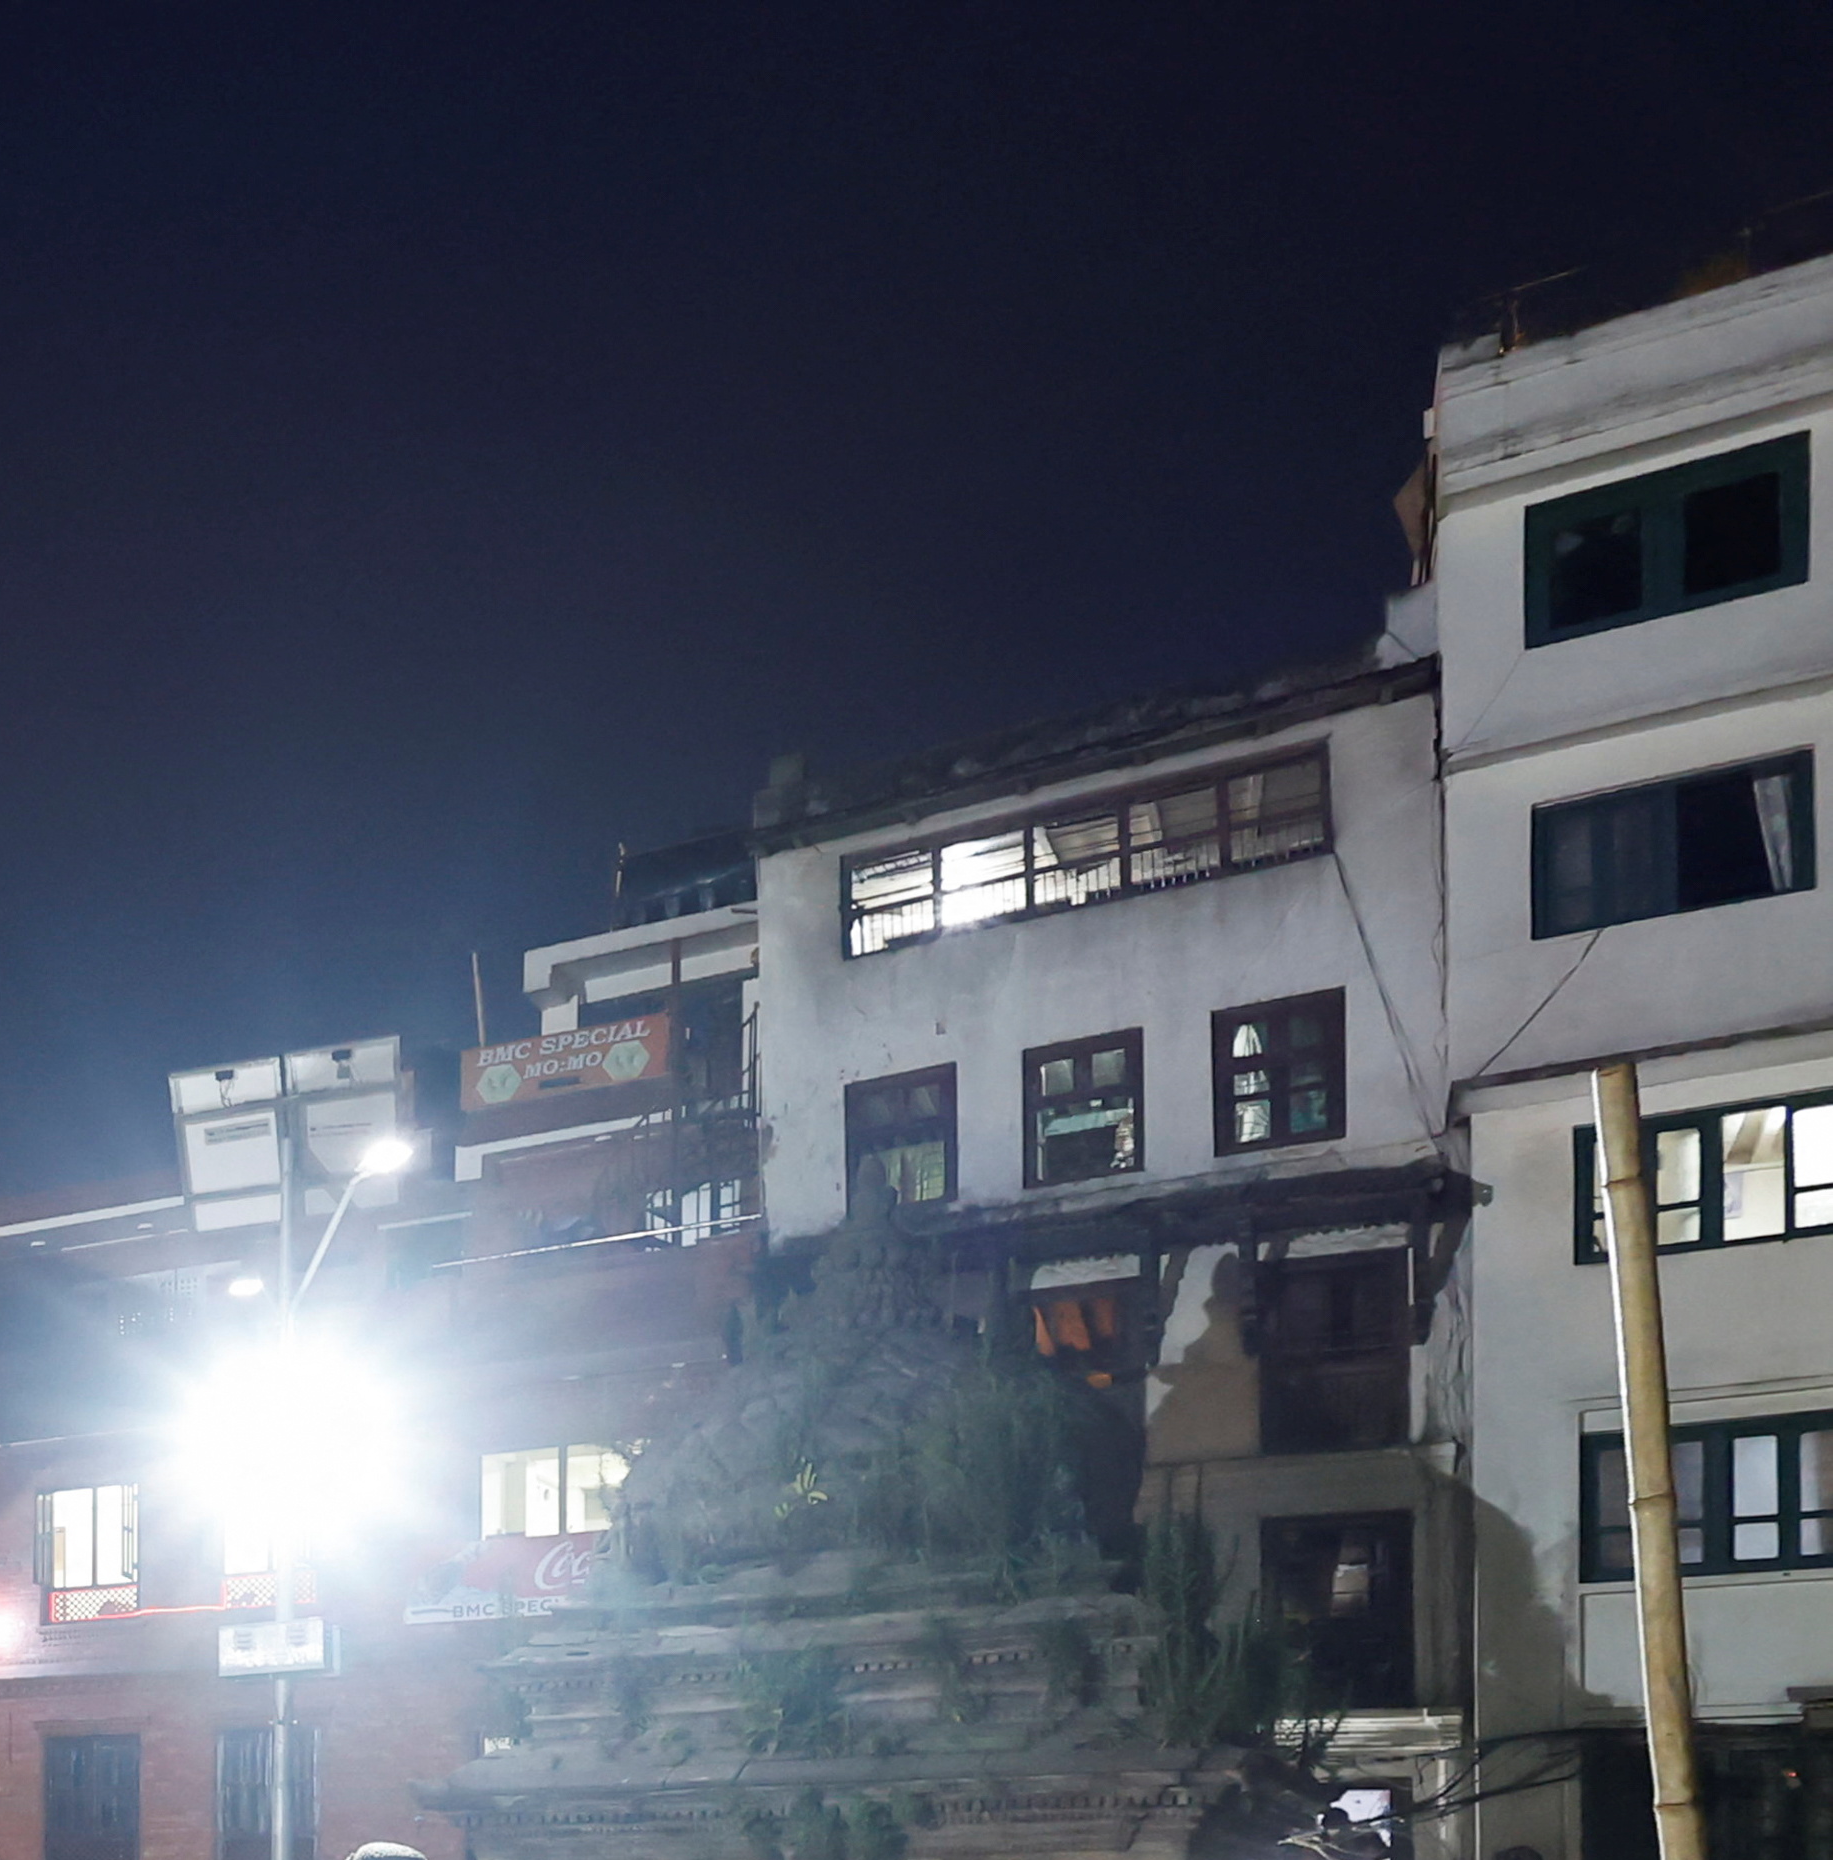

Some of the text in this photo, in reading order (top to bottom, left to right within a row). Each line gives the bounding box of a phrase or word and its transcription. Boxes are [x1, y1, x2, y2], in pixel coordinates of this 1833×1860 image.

[477, 1020, 651, 1067] BMC SPECIAL
[523, 1051, 603, 1080] MO:MO
[453, 1598, 558, 1618] BMC SPEC
